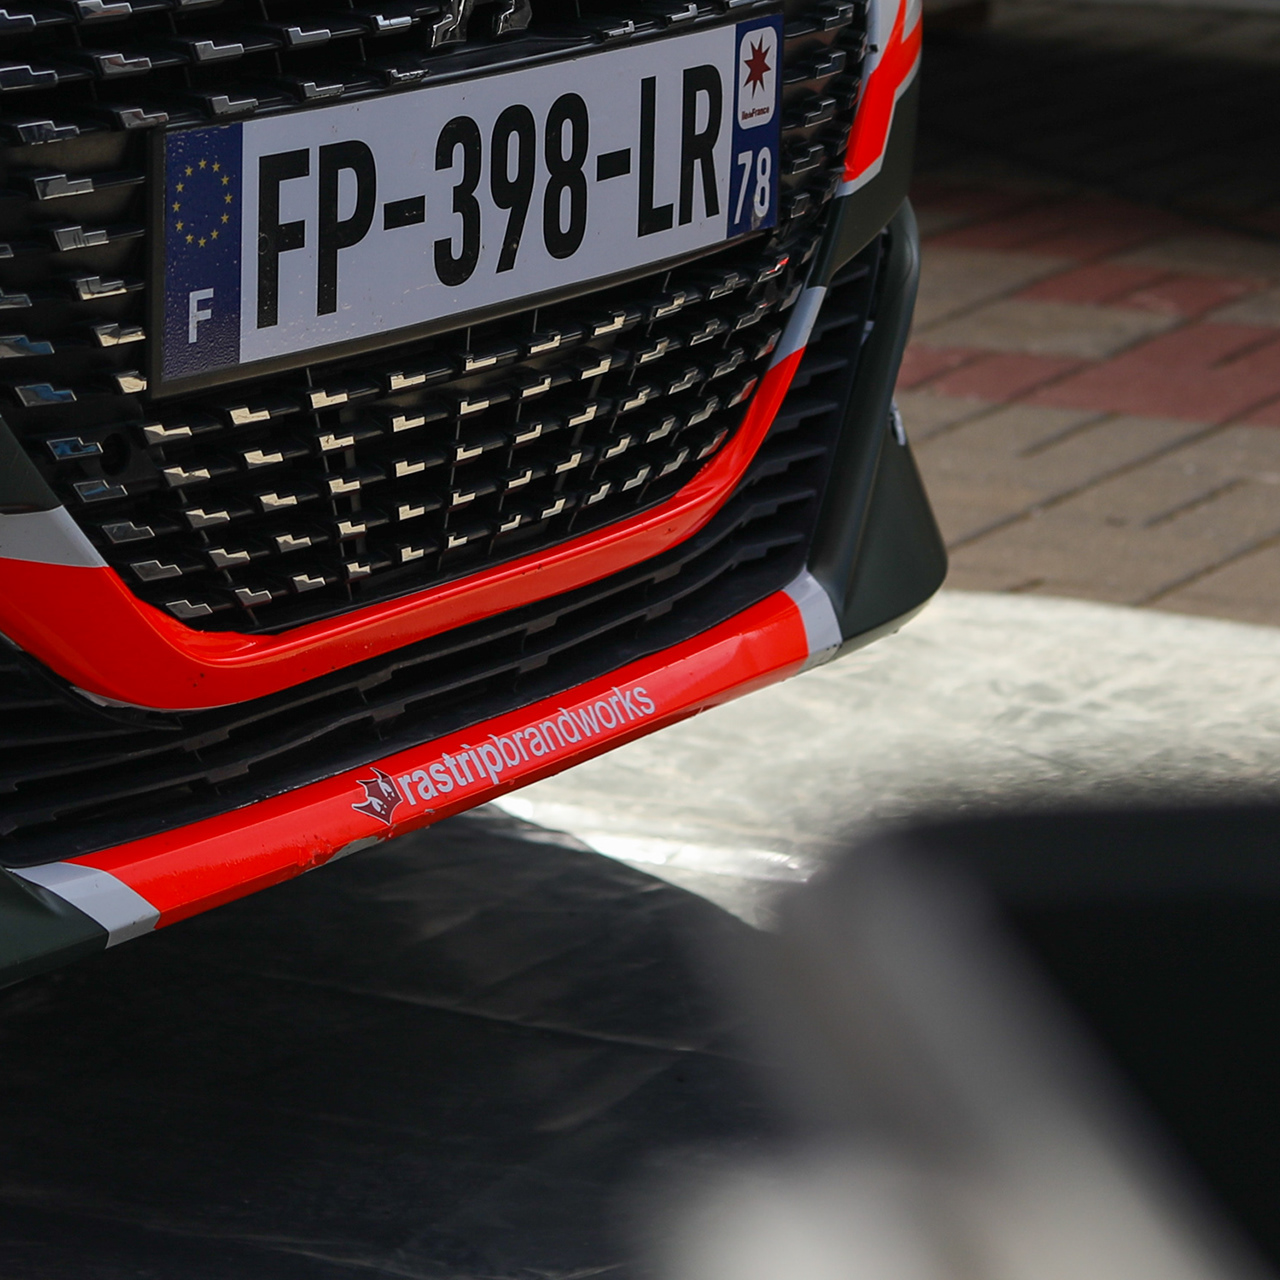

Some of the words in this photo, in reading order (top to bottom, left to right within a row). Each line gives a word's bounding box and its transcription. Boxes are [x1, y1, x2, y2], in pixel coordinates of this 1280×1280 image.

[255, 63, 722, 331] FP-398-LR
[735, 145, 773, 226] 78
[187, 287, 212, 344] F
